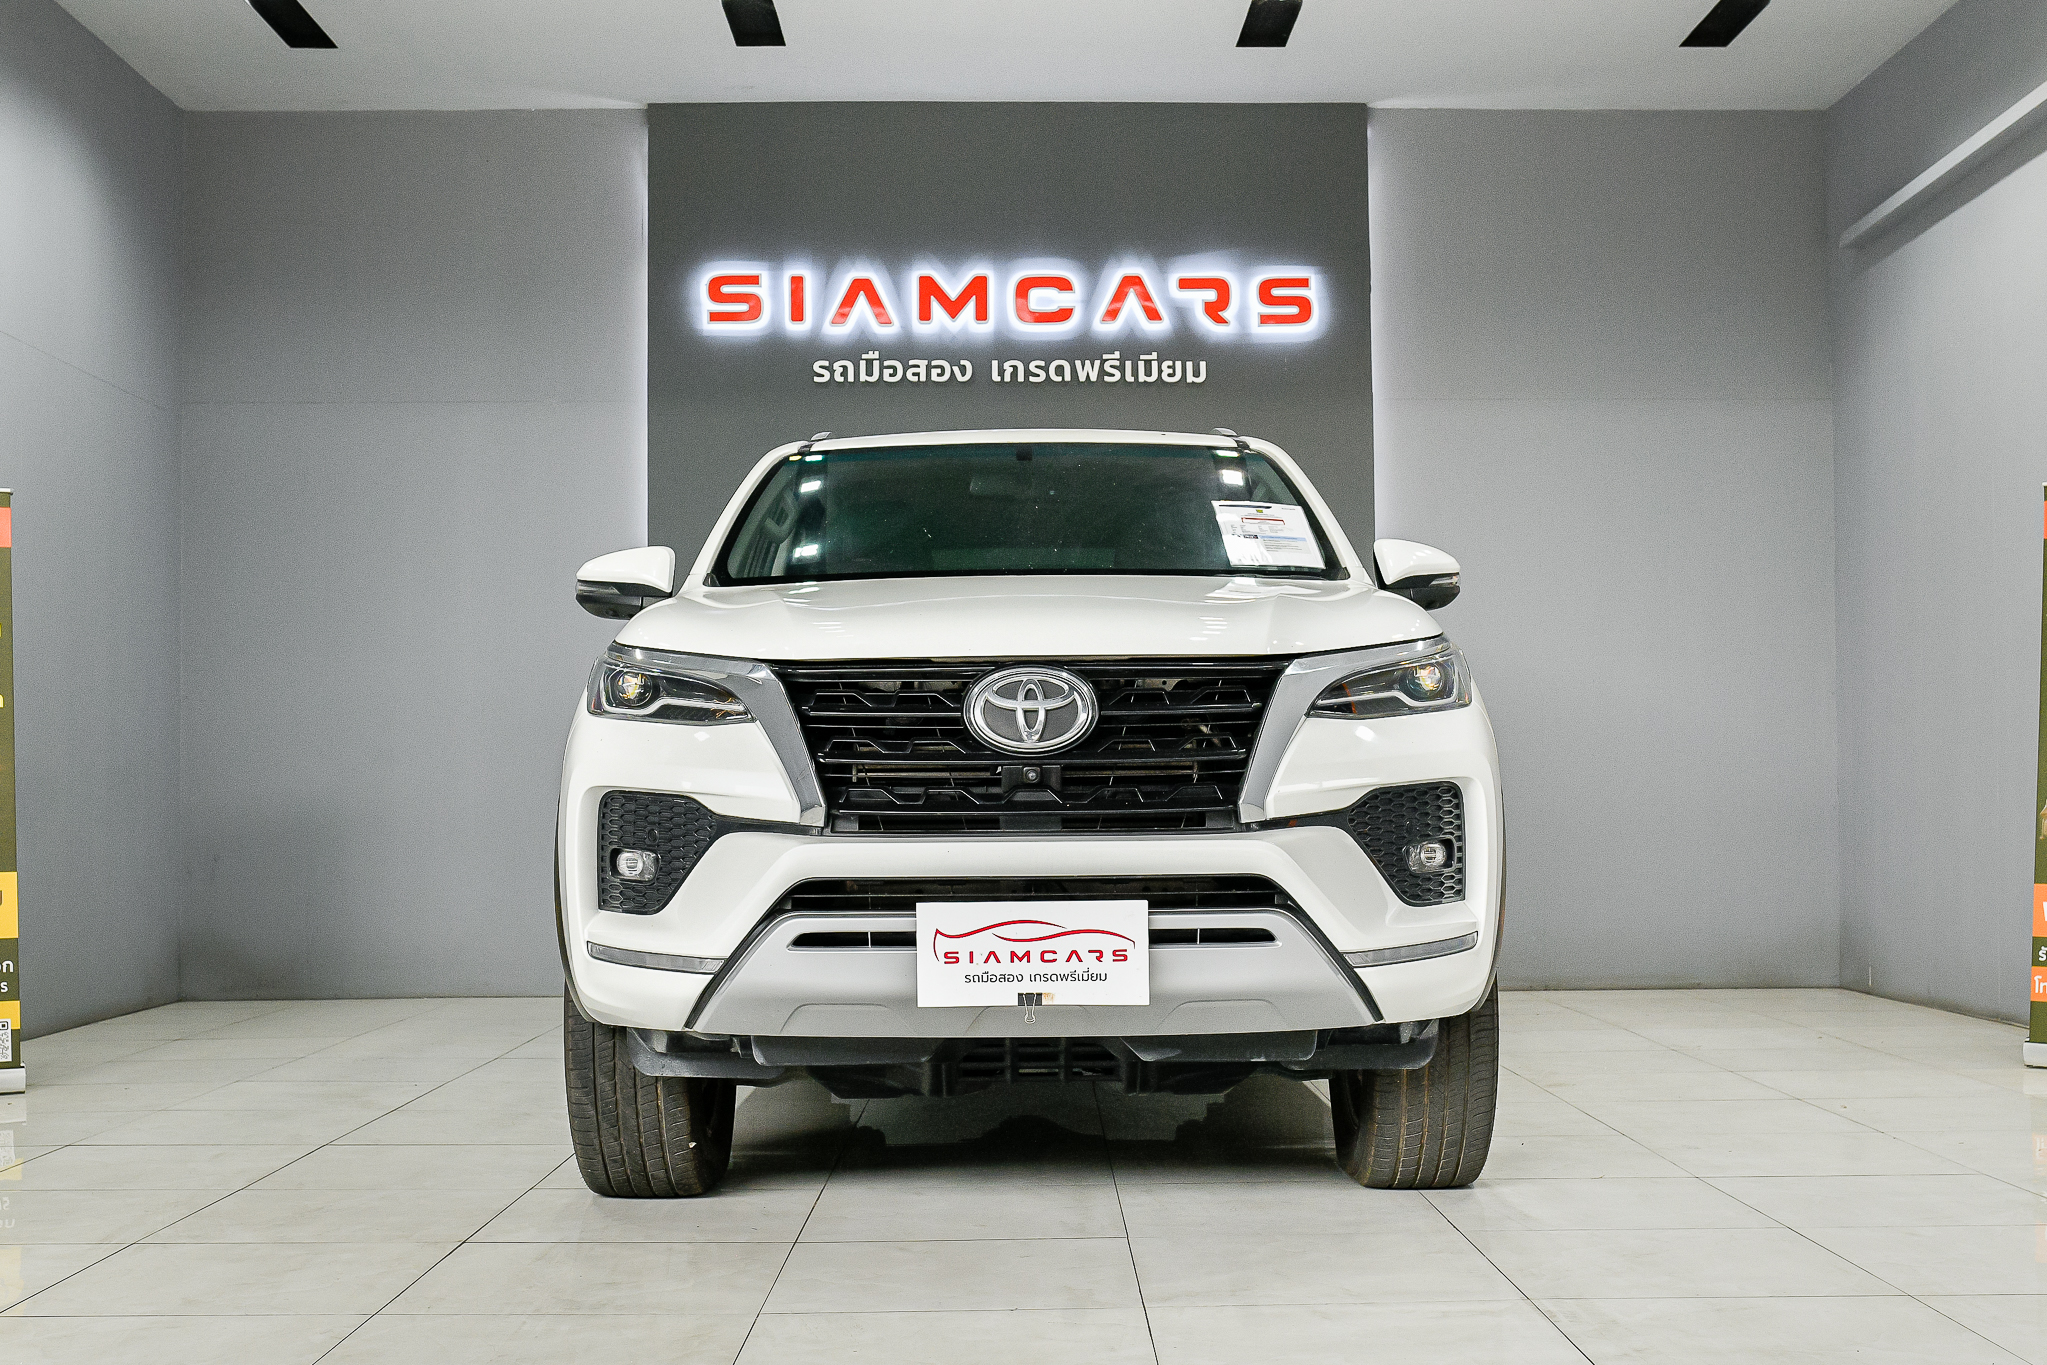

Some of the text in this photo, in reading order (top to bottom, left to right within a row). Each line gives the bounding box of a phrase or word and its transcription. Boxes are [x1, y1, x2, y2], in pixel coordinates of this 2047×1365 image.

[706, 273, 1314, 326] SIAMCARS
[812, 350, 1207, 384] รถมือสอง เกรดพรีเมียม
[943, 949, 1128, 965] SIAMCARS
[964, 967, 1108, 984] รถมือสอง เกรดพรีเมี่ยม
